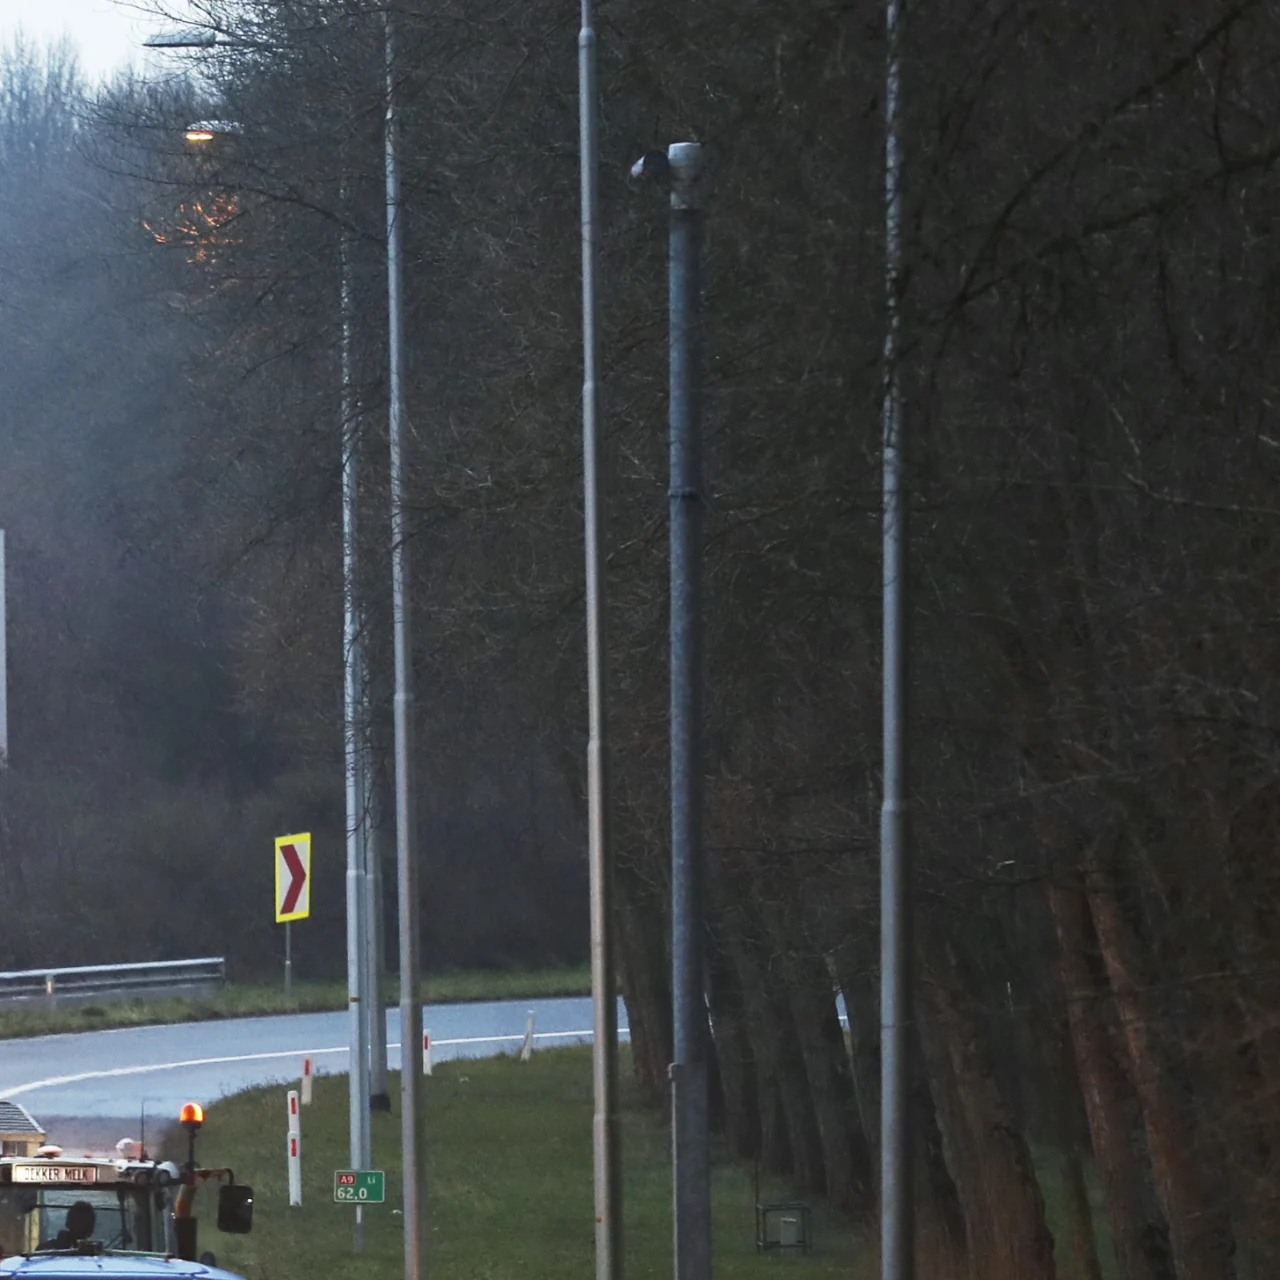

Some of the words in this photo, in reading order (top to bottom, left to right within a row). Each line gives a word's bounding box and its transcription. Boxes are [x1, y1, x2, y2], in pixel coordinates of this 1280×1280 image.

[24, 1167, 60, 1180] DEKKER
[64, 1167, 89, 1180] MELK
[340, 1175, 354, 1184] A9
